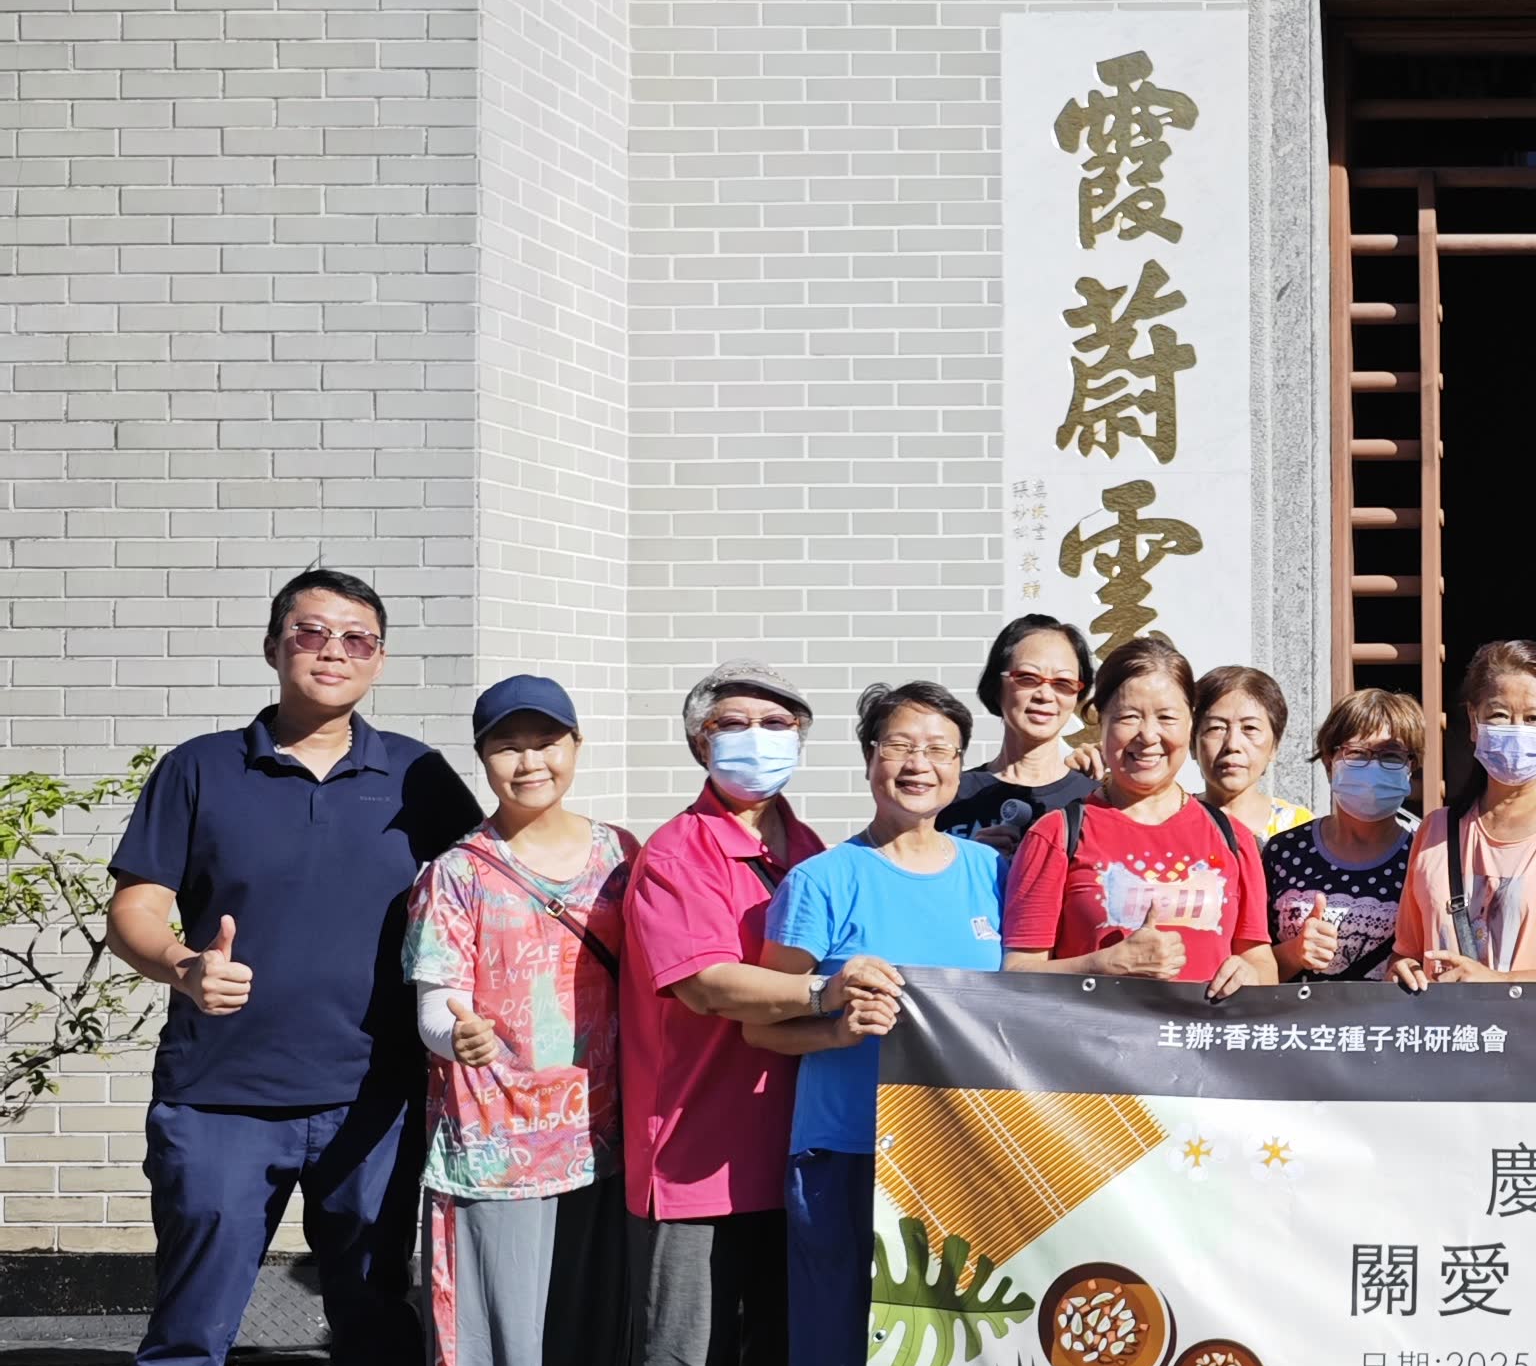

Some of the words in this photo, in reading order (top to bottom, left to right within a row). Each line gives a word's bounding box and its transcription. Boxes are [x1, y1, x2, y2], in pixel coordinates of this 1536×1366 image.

[1050, 49, 1204, 748] 霞蔚雲
[1156, 1020, 1509, 1054] 主辦:香港太空種子科研總會
